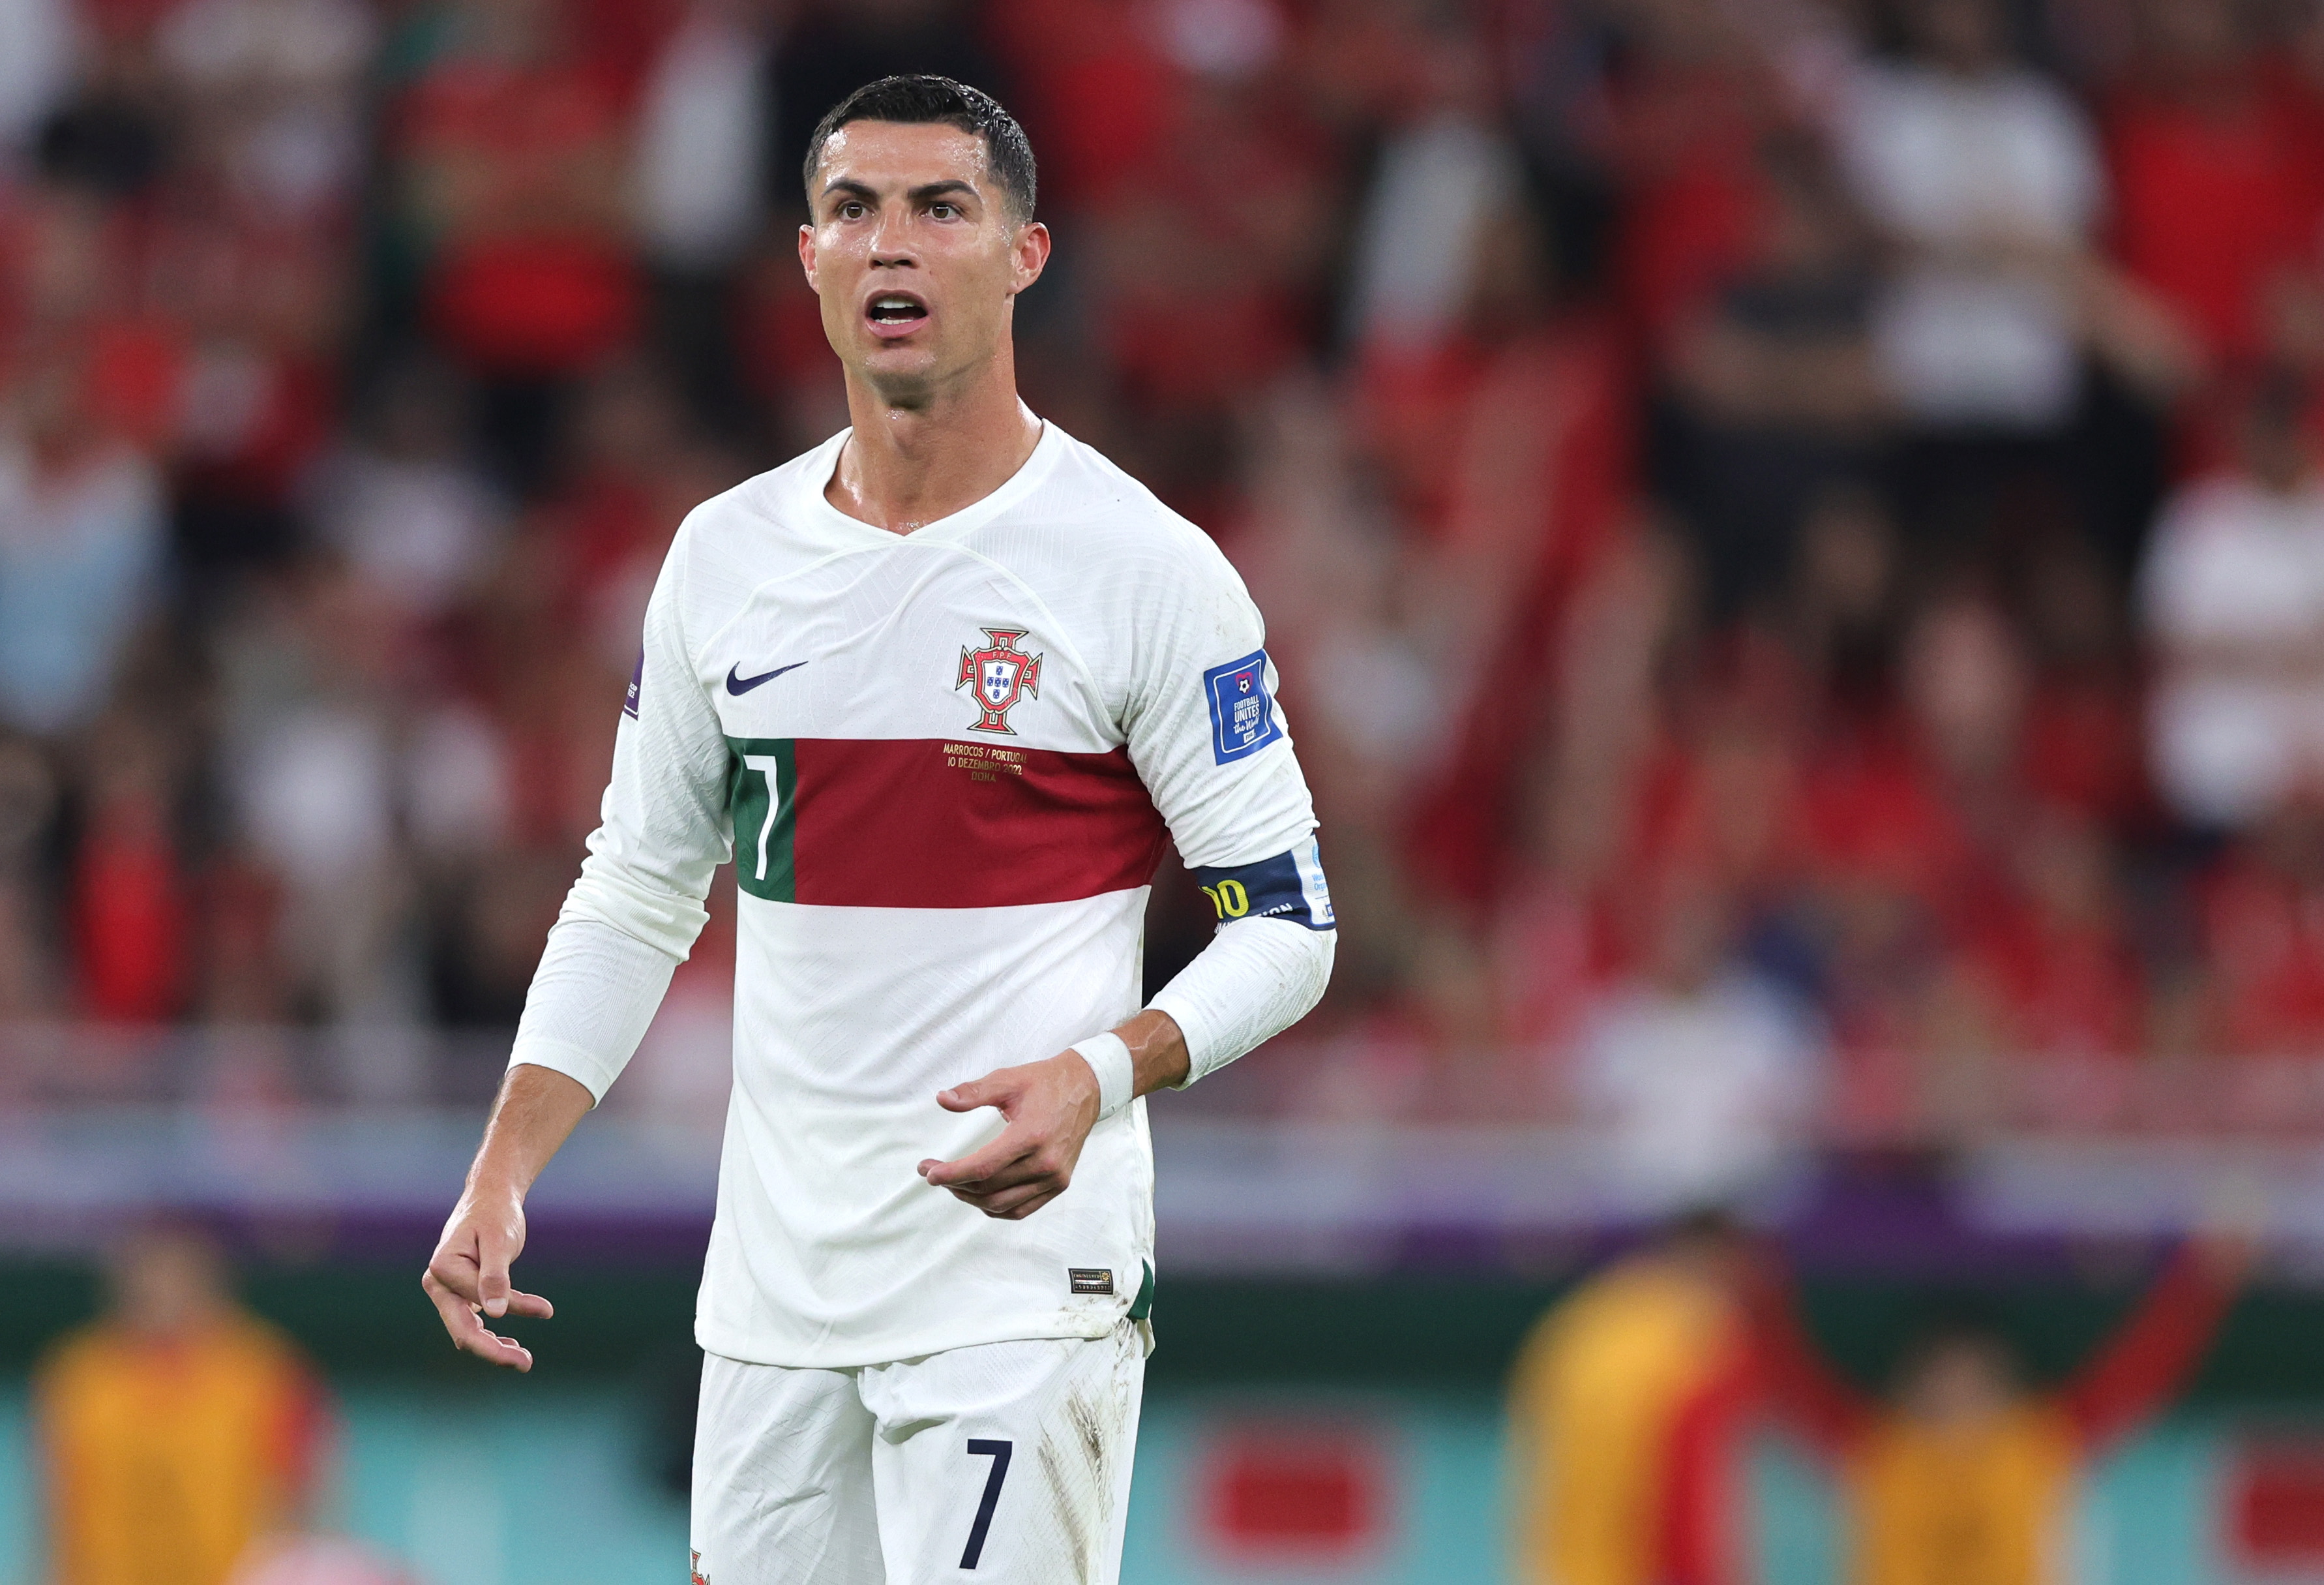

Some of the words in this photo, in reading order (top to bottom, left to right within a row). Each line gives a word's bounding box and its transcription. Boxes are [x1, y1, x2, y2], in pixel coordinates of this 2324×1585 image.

[1234, 694, 1259, 712] FOOTBALL
[1234, 703, 1260, 723] UNITES
[1233, 723, 1245, 734] the
[944, 743, 984, 757] MARROCOS
[991, 749, 1027, 763] PORTUGAL
[958, 757, 1001, 771] DEZEMBRO
[1003, 764, 1022, 775] 2022
[972, 772, 996, 782] DOHA
[743, 755, 779, 881] 7
[959, 1438, 1013, 1569] 7
